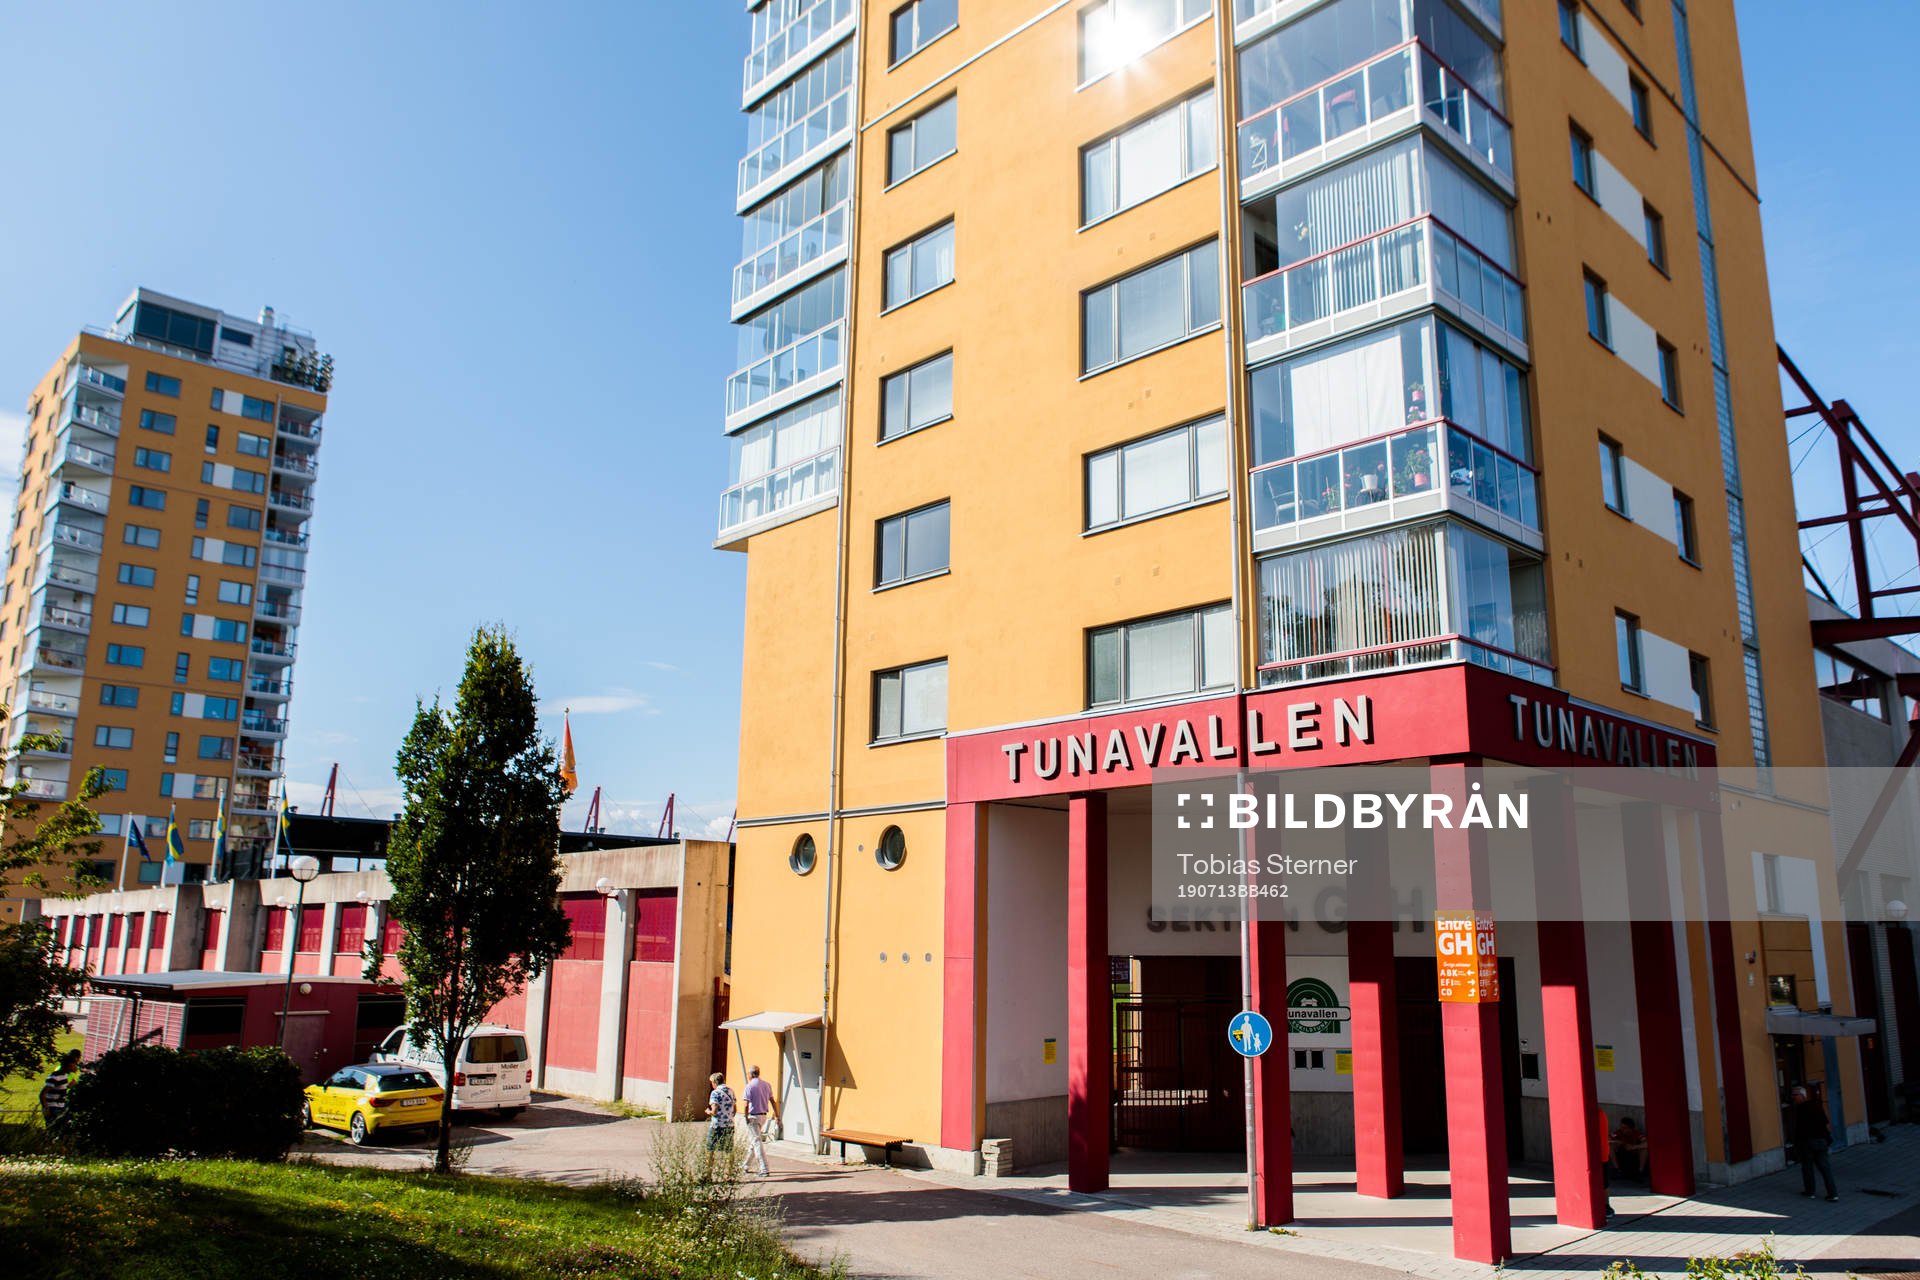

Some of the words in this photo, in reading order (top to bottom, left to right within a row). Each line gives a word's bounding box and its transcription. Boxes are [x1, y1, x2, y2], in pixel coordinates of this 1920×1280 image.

[1001, 695, 1372, 782] TUNAVALLEN
[1509, 694, 1699, 782] TUNAVALLEN
[1146, 904, 1299, 933] SEKTN
[1437, 915, 1473, 931] Entré
[1438, 932, 1473, 956] GH
[1477, 932, 1495, 956] GH
[1288, 1009, 1338, 1019] unavallen
